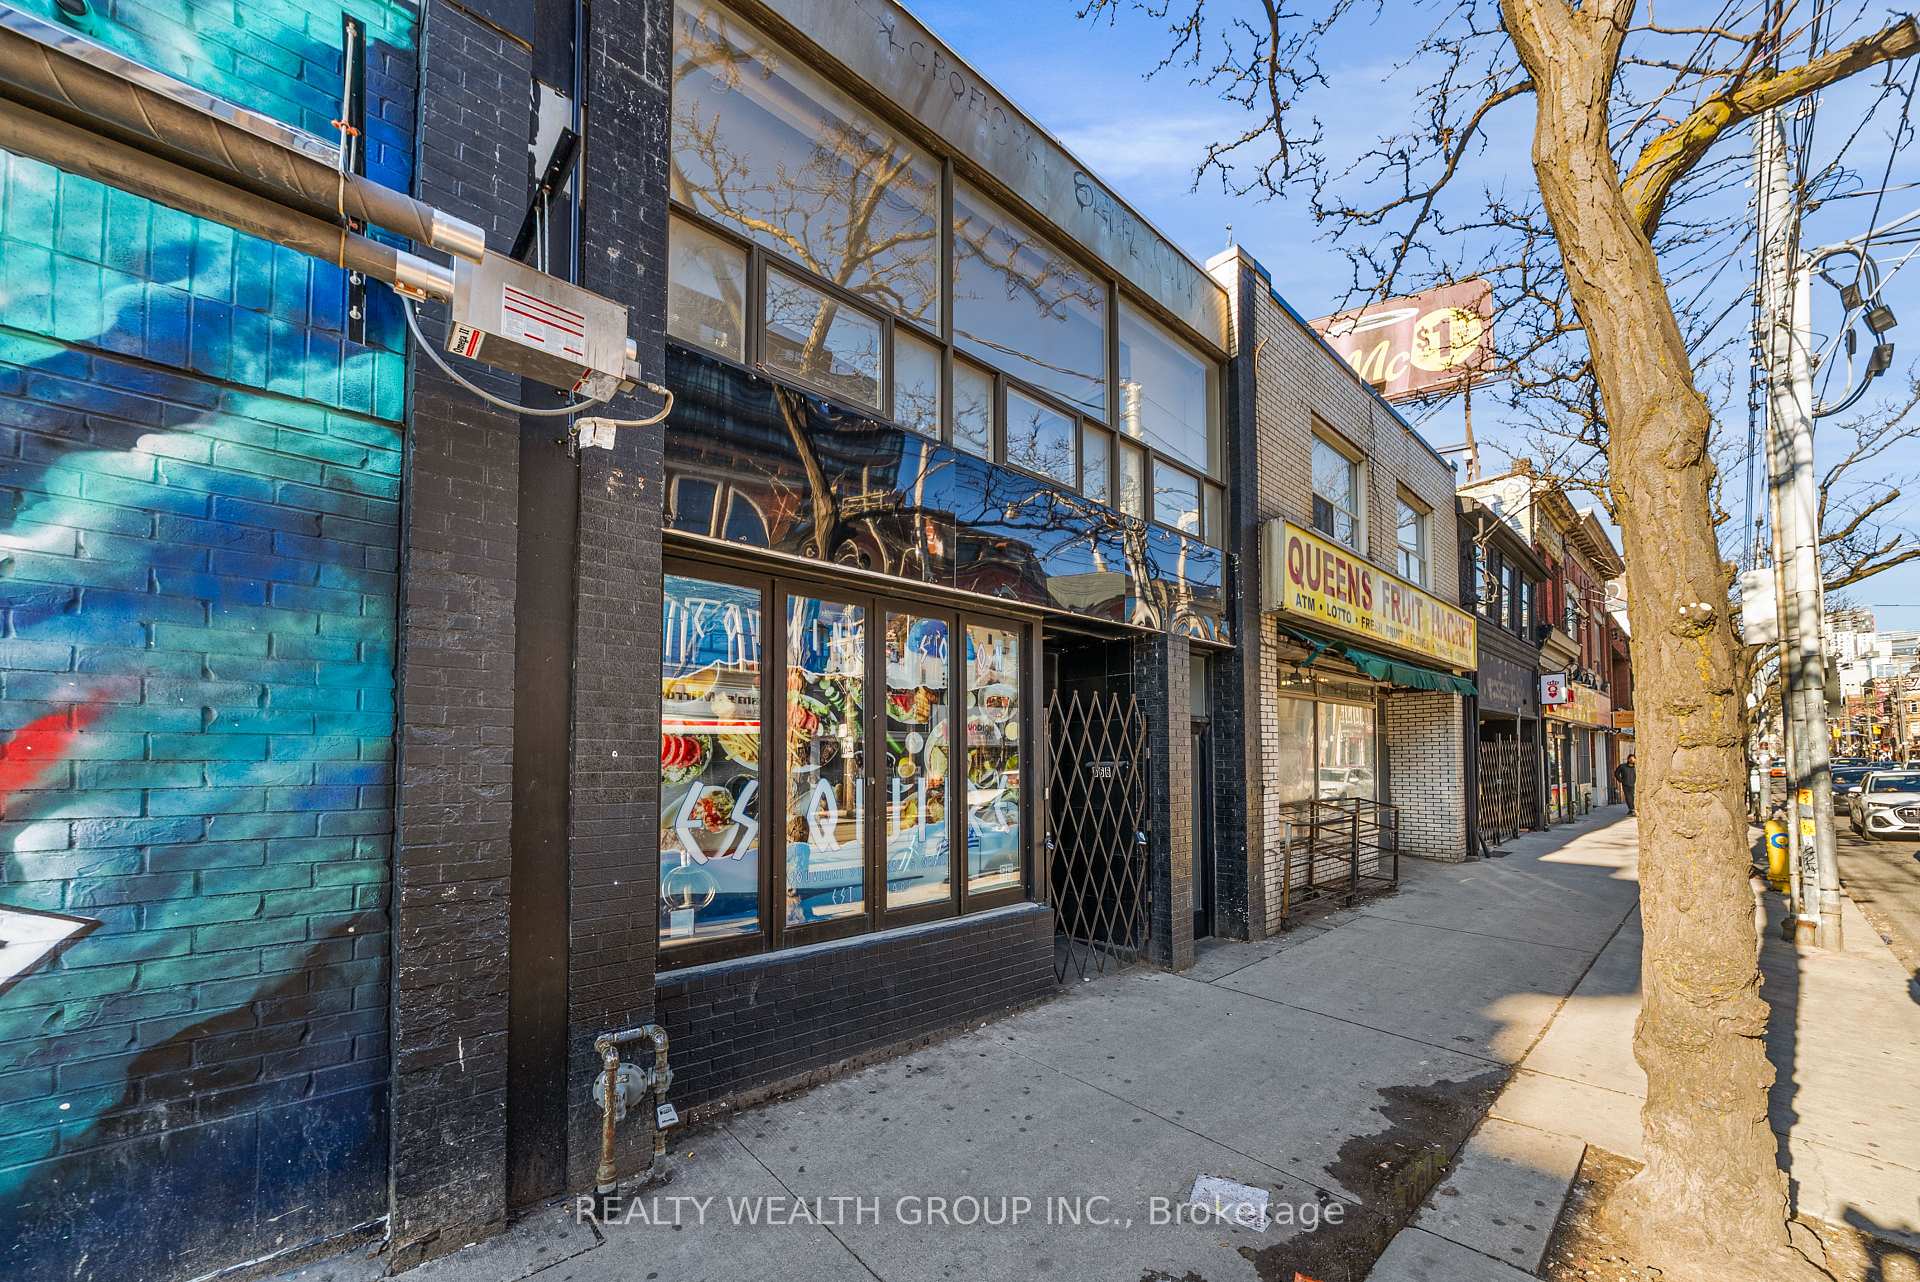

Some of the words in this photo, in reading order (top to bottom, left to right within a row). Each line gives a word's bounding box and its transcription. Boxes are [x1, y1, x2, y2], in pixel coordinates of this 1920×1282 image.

[1288, 536, 1373, 611] QUEENS
[1382, 580, 1423, 635] FRUIT
[1296, 593, 1316, 612] ATM
[1327, 603, 1352, 624] LOTTO
